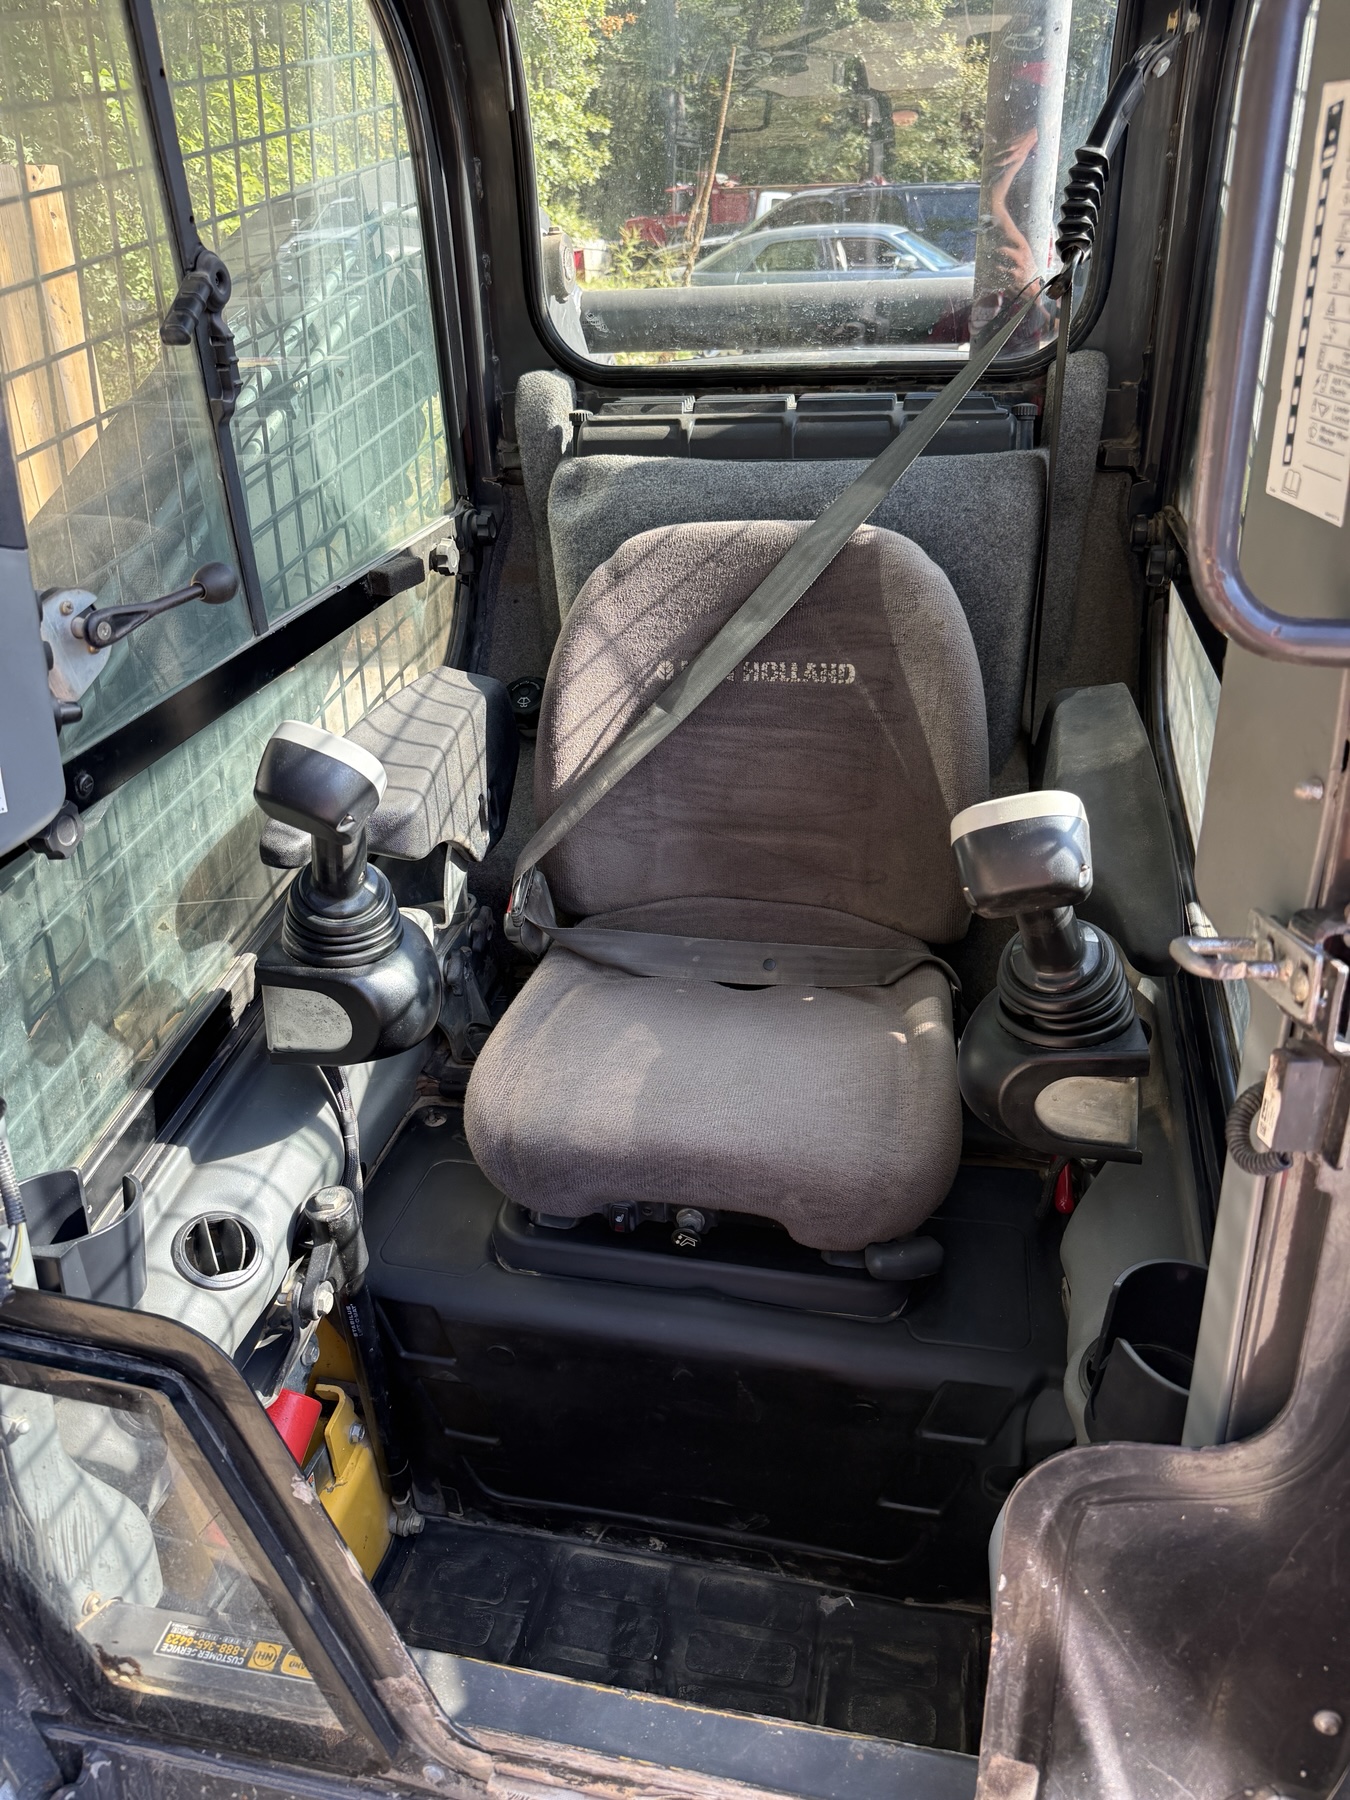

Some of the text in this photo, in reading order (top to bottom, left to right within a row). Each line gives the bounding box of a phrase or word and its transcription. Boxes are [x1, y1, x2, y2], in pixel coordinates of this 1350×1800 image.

[743, 661, 856, 684] HOLLAND
[164, 1633, 250, 1658] 1-888-365-6423
[197, 1650, 245, 1665] CUSTOMER
